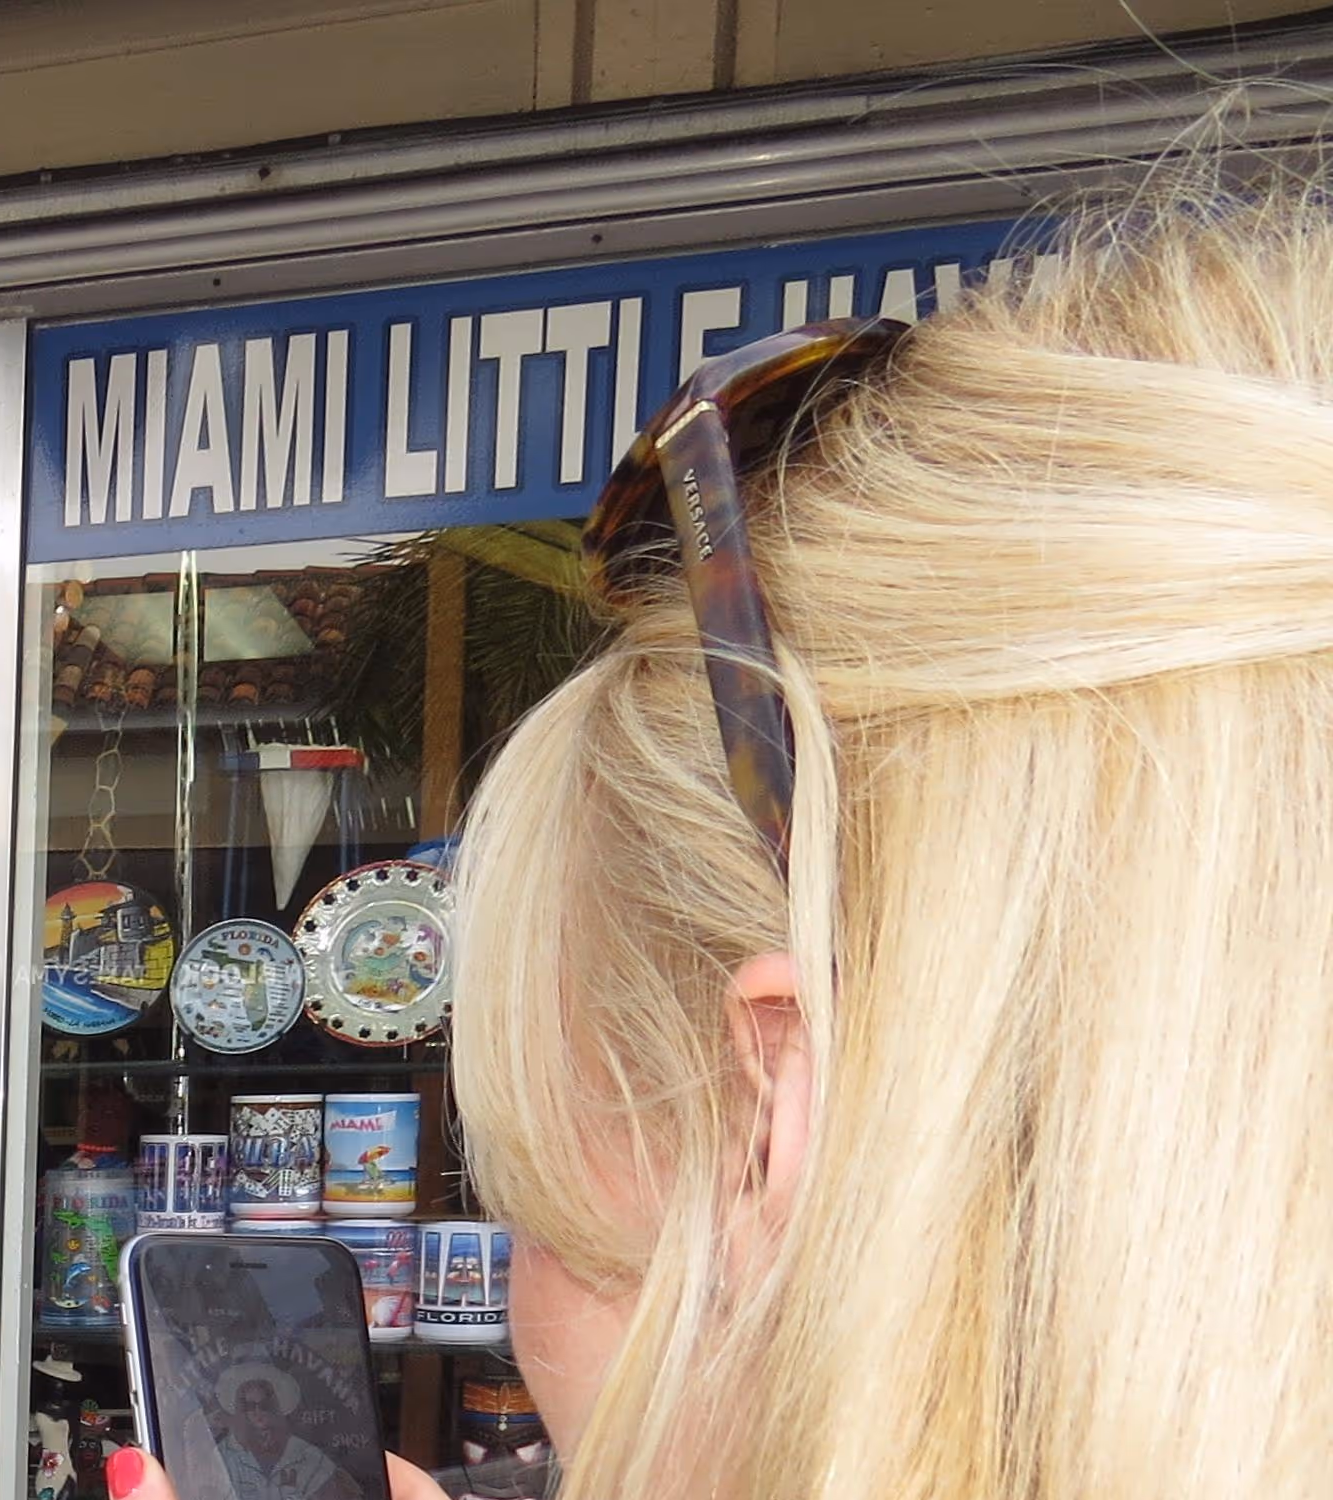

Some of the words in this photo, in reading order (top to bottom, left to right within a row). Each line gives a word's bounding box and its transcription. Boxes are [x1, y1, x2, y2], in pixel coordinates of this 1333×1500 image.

[64, 327, 350, 527] MIAMI
[681, 468, 714, 562] VERSACE
[221, 930, 280, 948] FLORIDA
[330, 1118, 383, 1131] MIAMI
